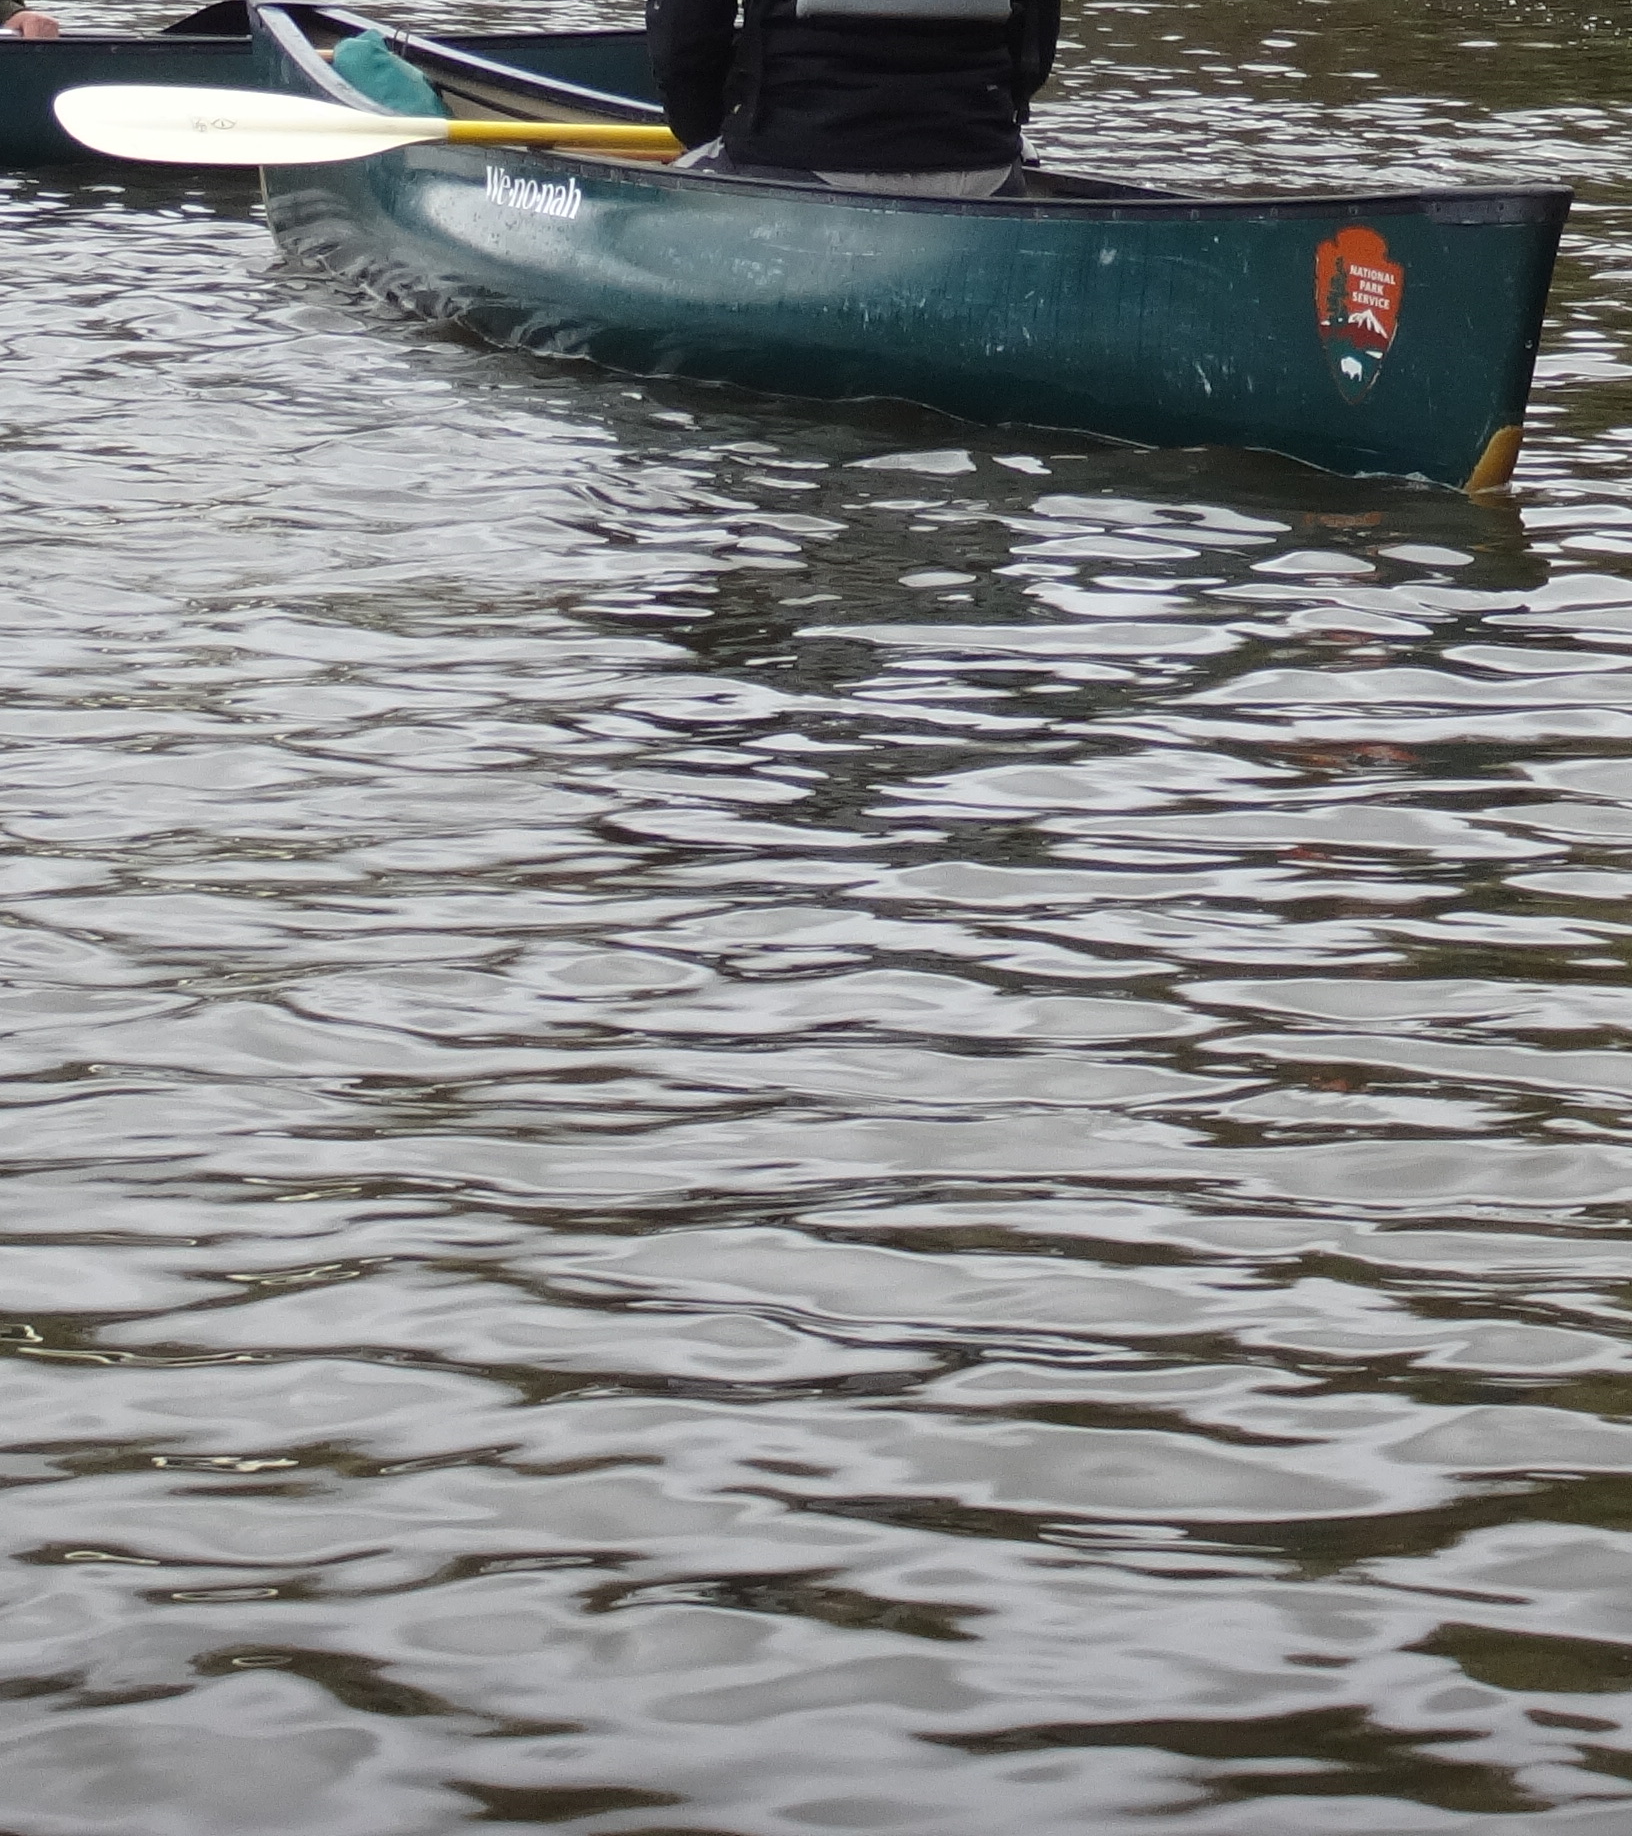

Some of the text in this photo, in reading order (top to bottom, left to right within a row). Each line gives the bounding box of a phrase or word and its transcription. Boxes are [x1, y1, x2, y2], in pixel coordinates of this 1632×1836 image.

[1350, 264, 1396, 285] NATIONAL
[1359, 279, 1384, 295] PARK
[1352, 291, 1391, 310] SERVICE
